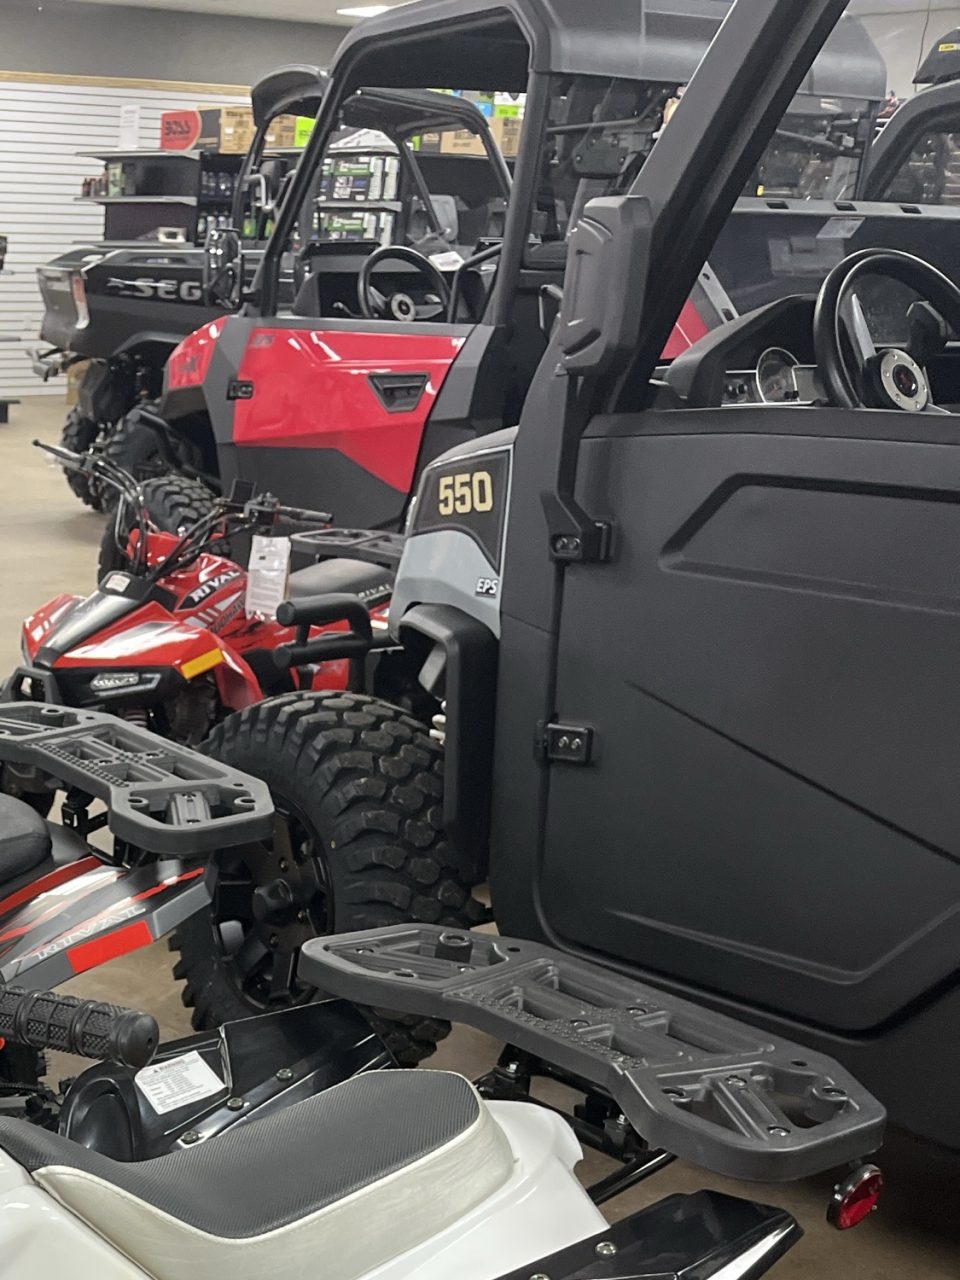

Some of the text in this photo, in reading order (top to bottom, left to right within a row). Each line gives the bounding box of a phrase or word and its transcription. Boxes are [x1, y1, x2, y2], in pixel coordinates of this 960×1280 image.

[438, 469, 494, 516] 550
[189, 570, 241, 603] RIVAL
[476, 577, 499, 596] EPS
